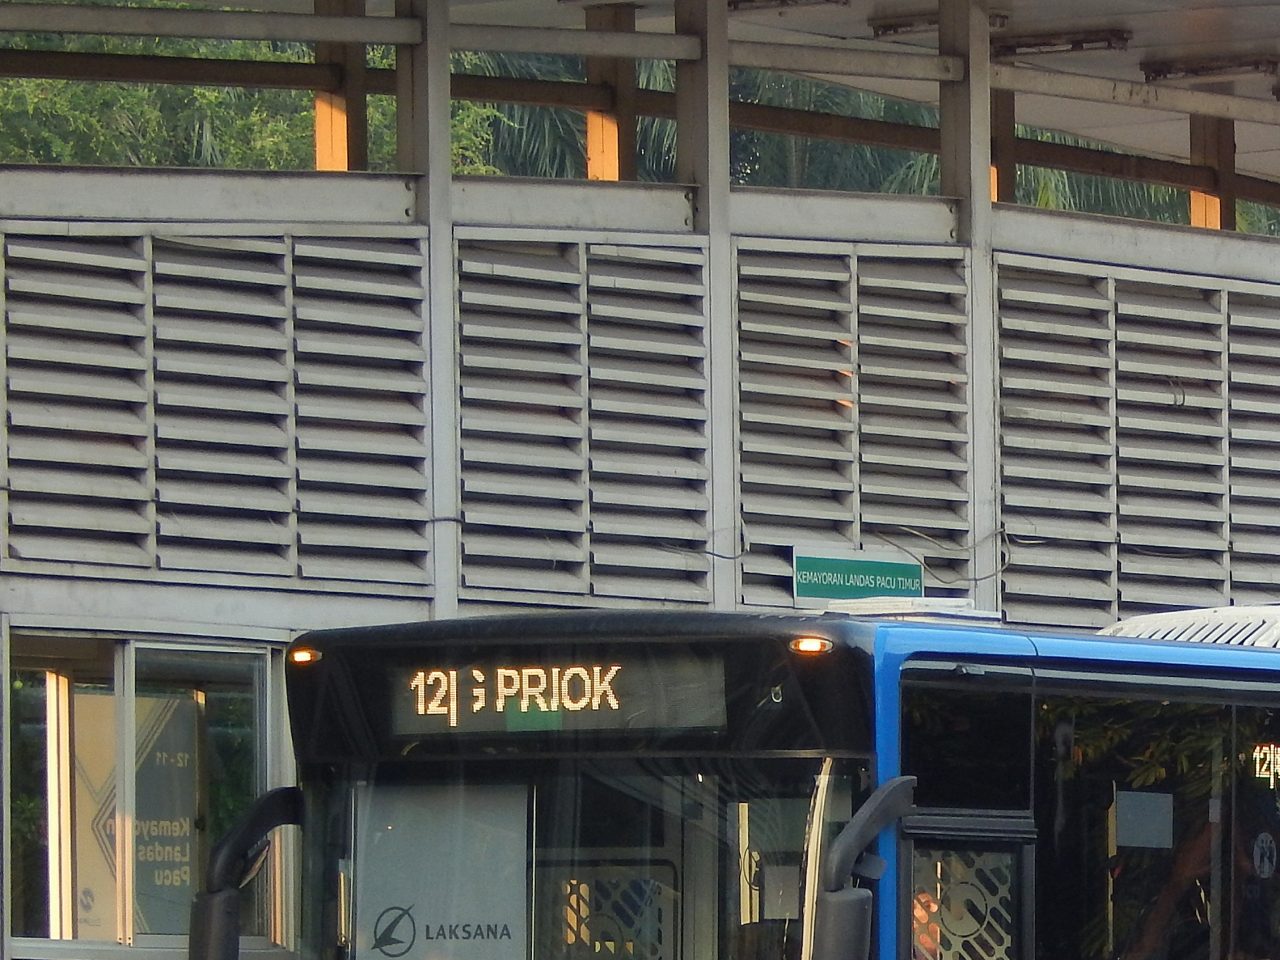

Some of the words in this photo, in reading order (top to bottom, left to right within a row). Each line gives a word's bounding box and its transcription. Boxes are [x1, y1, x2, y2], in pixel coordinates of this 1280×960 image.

[796, 571, 844, 586] KEMAYORAN
[845, 573, 875, 588] LANDAS
[876, 577, 896, 589] PACU
[898, 577, 921, 590] TIMUR
[496, 666, 622, 712] PRIOK
[425, 924, 512, 940] LAKSANA
